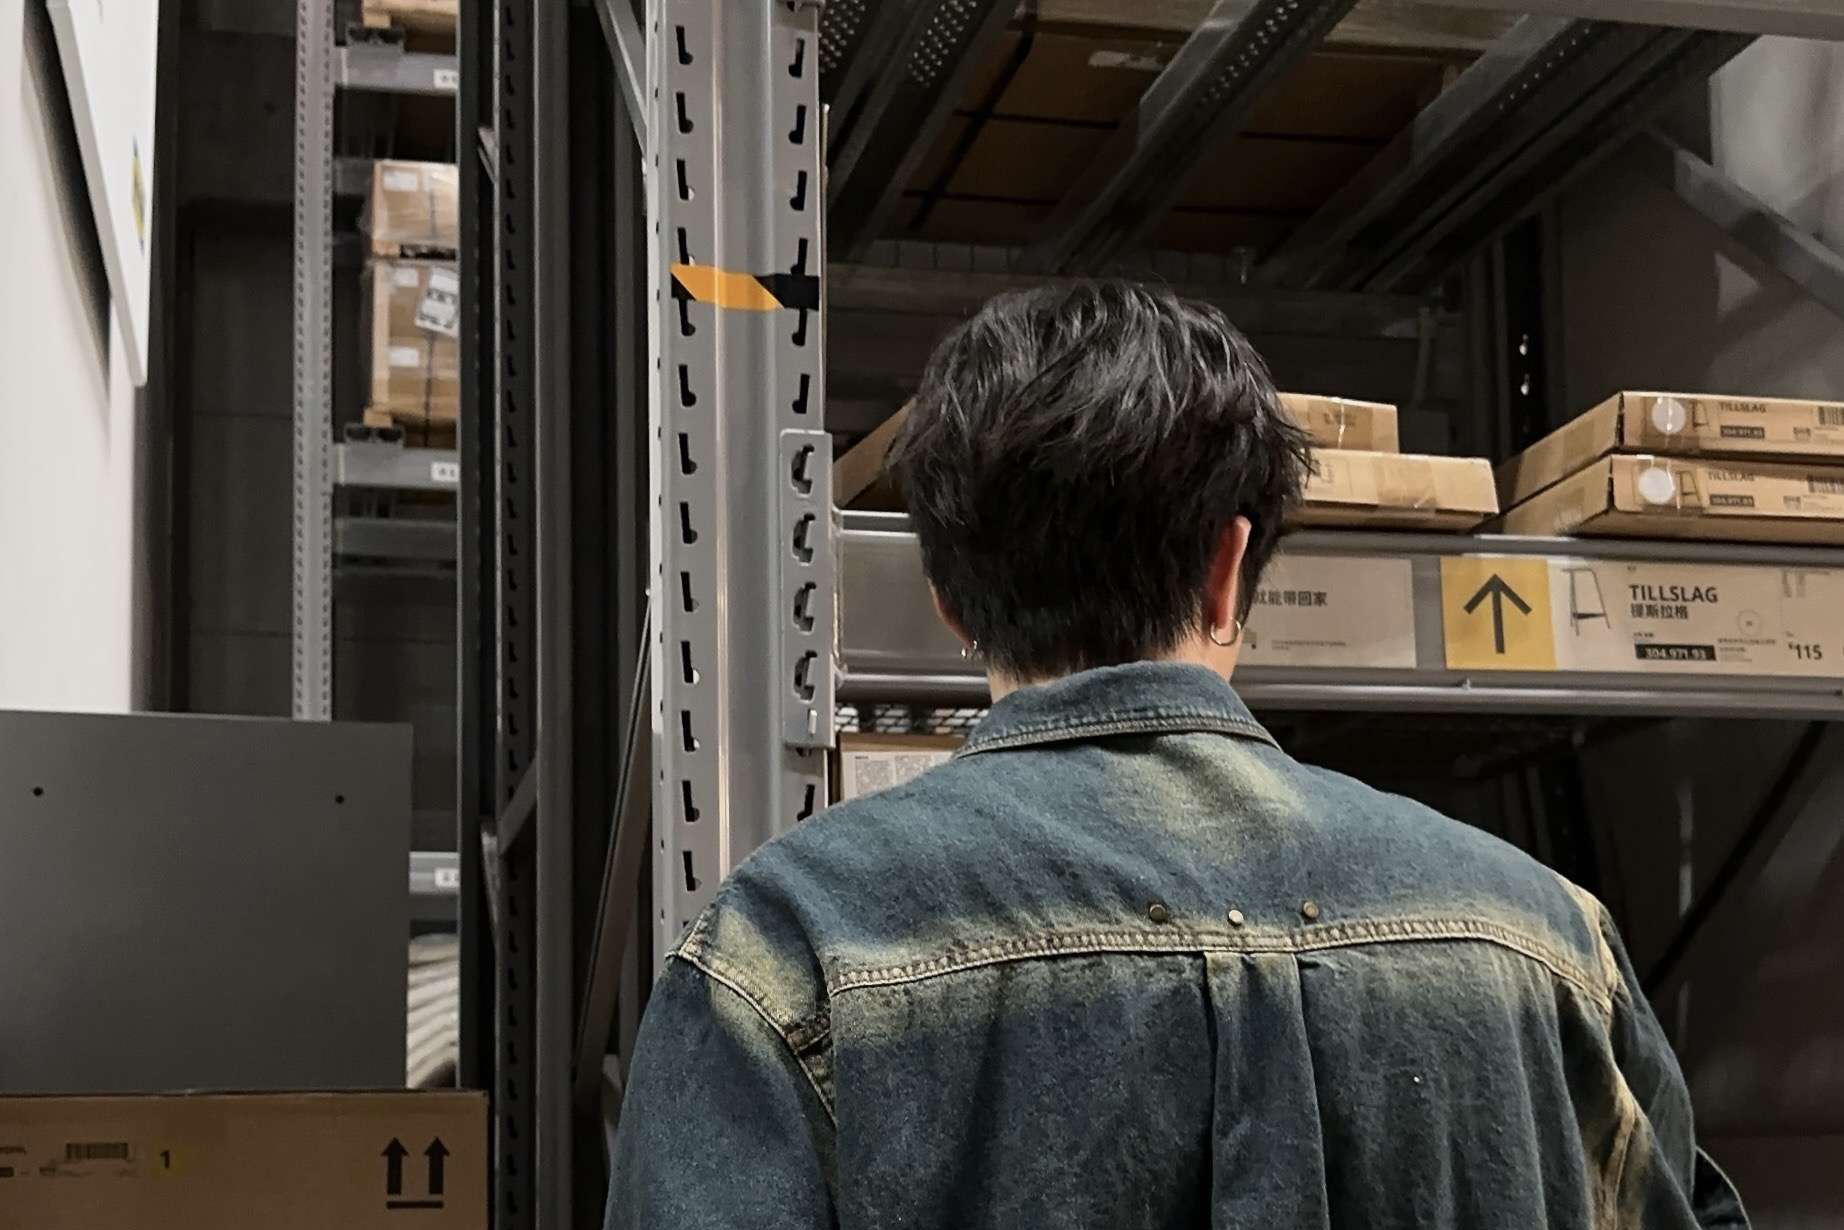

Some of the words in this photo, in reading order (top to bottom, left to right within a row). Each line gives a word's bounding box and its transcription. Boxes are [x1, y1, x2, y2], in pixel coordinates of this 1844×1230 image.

[1718, 401, 1767, 414] TILLSLAG
[1628, 584, 1719, 603] TILLSLAG
[160, 1150, 170, 1169] 1
